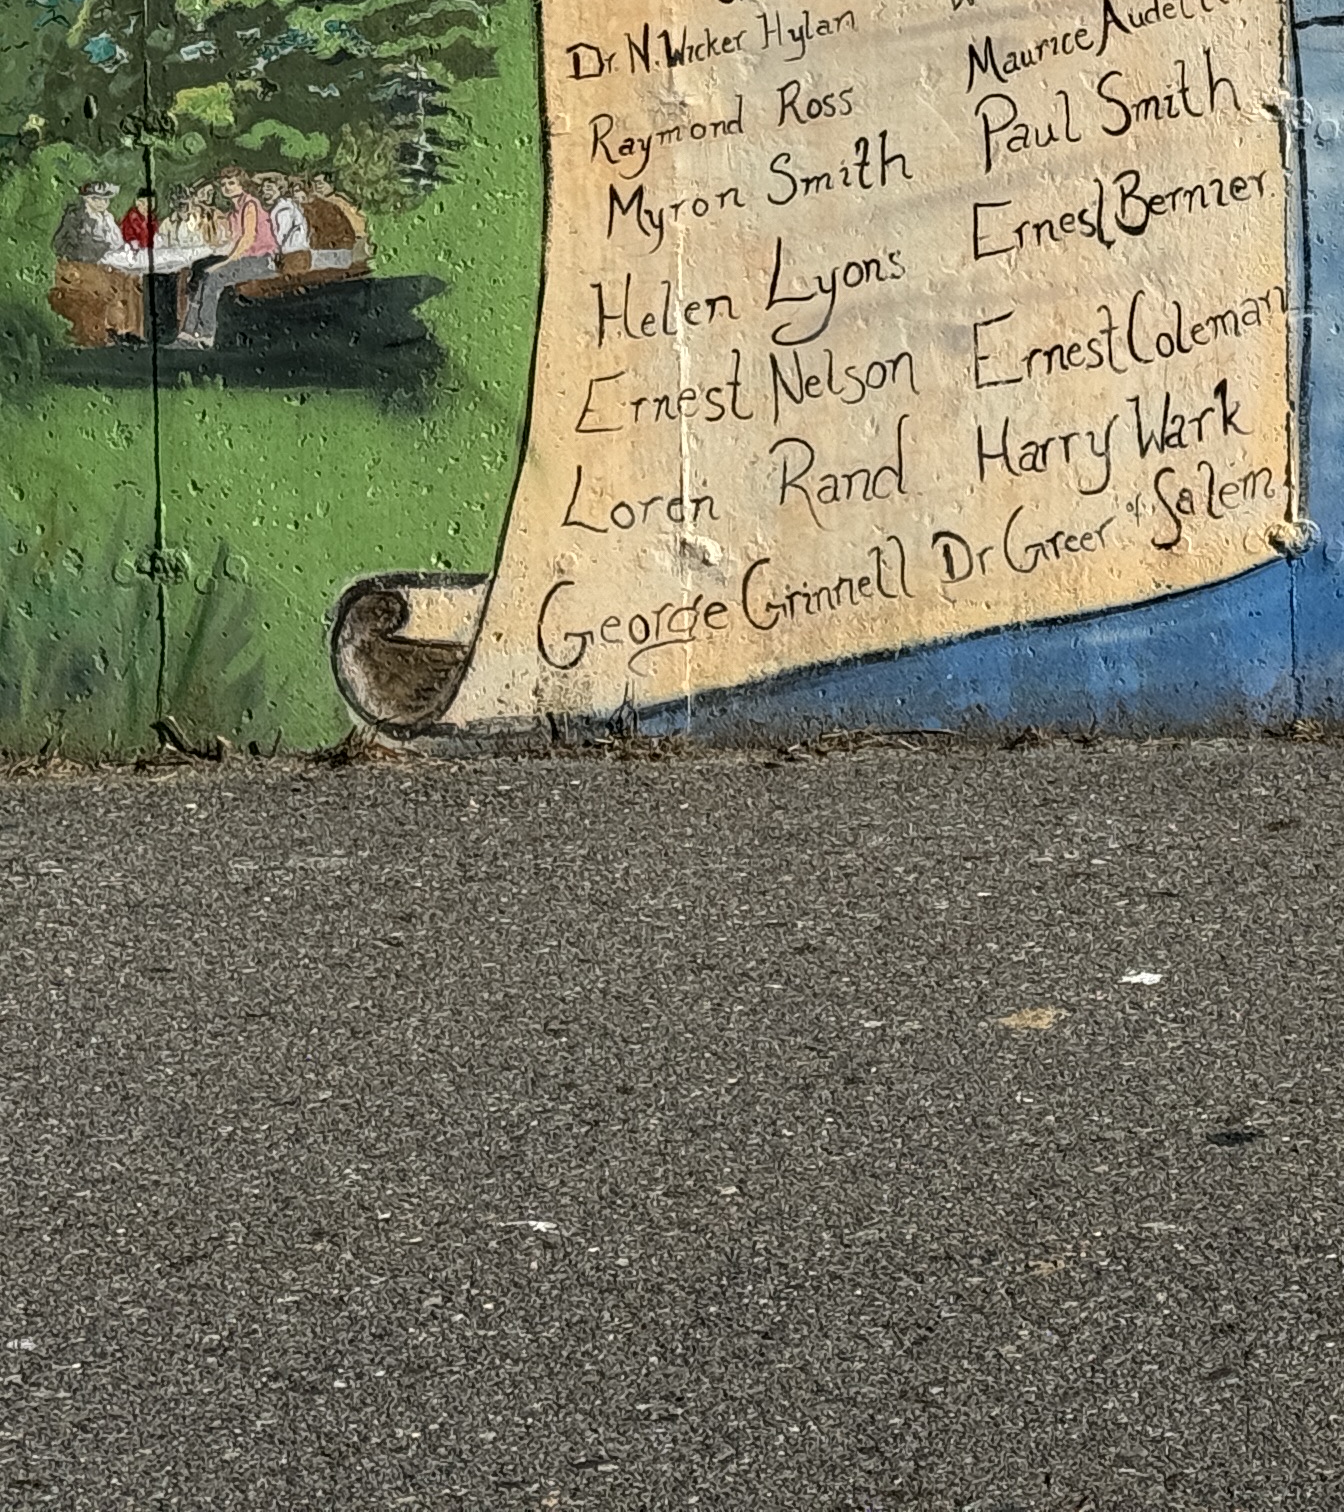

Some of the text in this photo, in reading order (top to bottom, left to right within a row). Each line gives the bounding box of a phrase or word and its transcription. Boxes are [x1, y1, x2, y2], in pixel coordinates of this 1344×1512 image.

[756, 10, 859, 63] Hylan
[965, 35, 1094, 95] Maurice
[588, 79, 855, 180] Raymond Ross
[974, 47, 1242, 174] Paul Smith
[606, 129, 914, 256] Myron Smith
[1113, 169, 1267, 236] Bernier
[590, 237, 906, 348] Helen Lyons
[973, 286, 1290, 389] Ernest Coleman
[575, 349, 921, 434] Ernest Nelson
[977, 377, 1254, 497] Harry Wark
[561, 413, 911, 534] Loren Rand
[931, 460, 1275, 584] Dr Greer of Salem
[537, 535, 915, 676] George Grinnell
